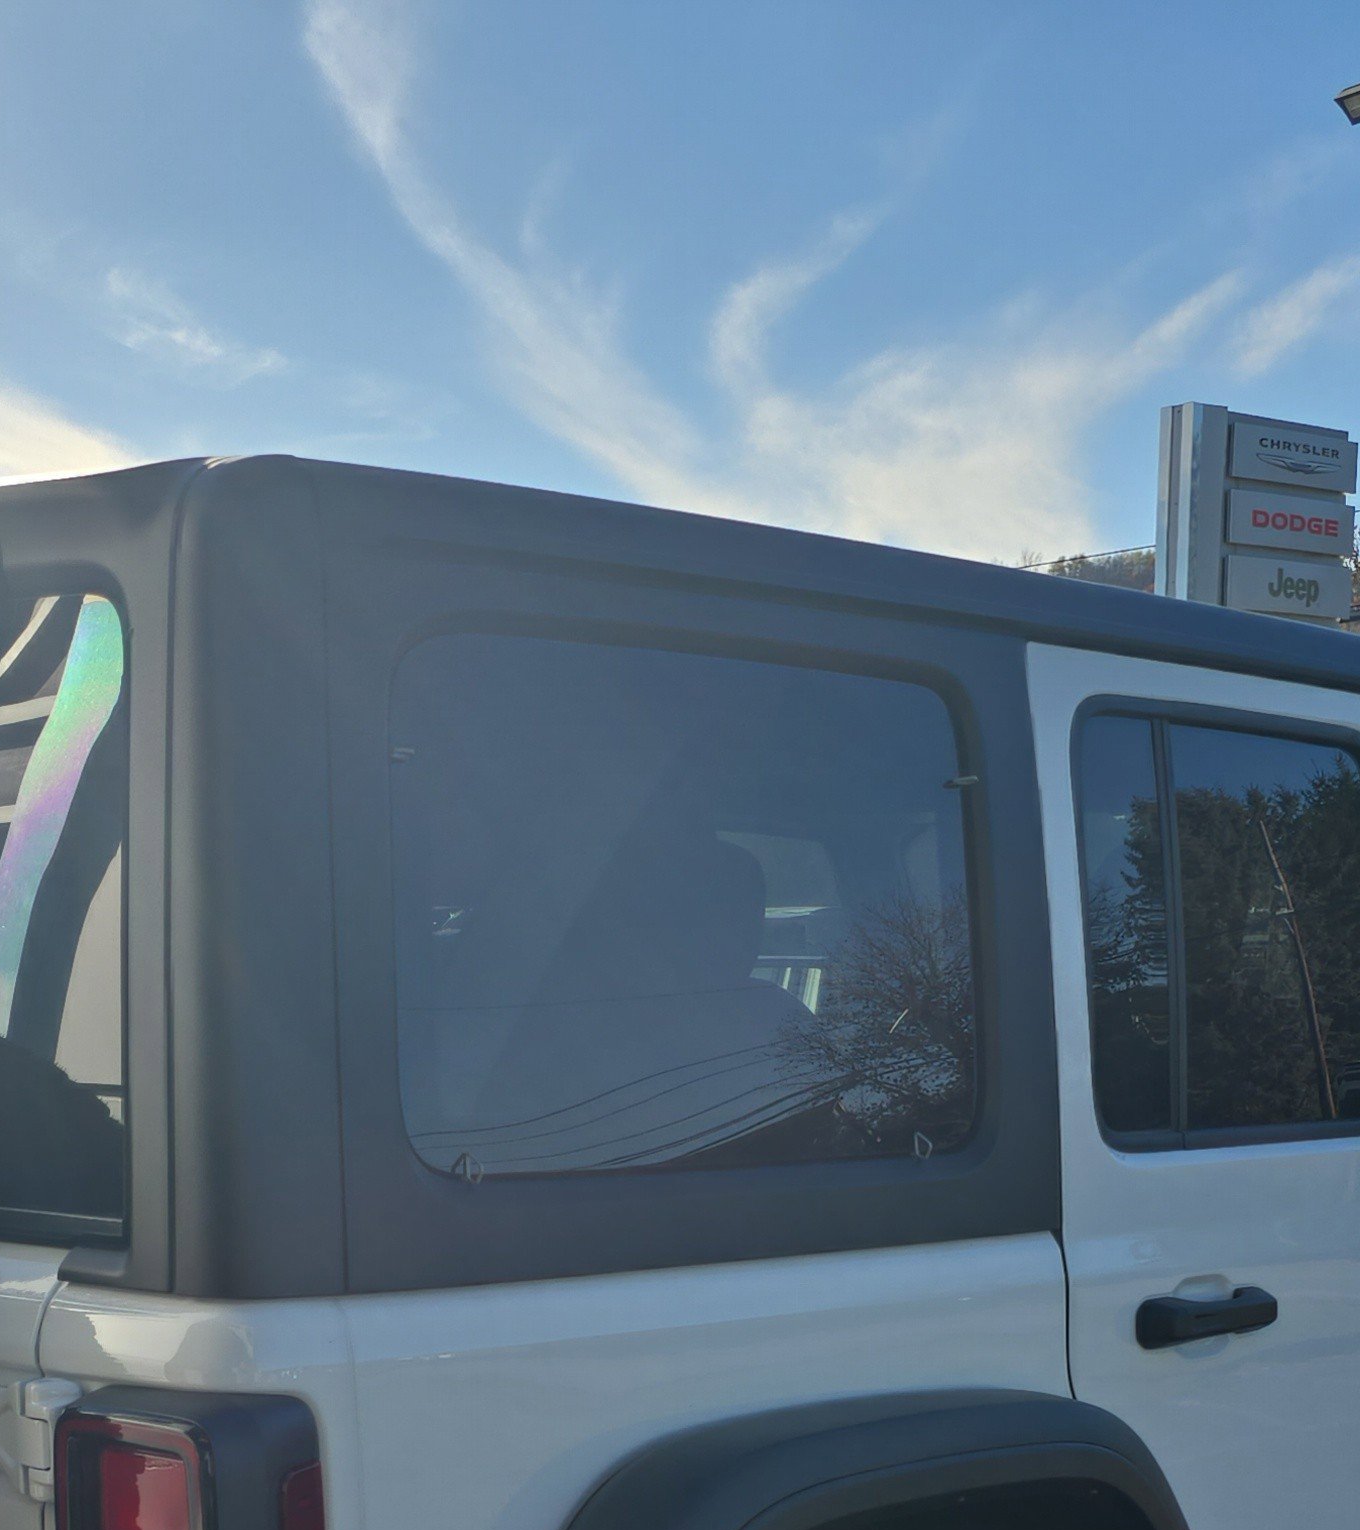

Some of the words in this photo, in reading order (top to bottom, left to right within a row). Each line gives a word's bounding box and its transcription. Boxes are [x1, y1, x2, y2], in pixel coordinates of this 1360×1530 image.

[1258, 437, 1340, 459] CHRYSLER
[1251, 509, 1340, 537] DODGE
[1268, 567, 1320, 607] Jeep
